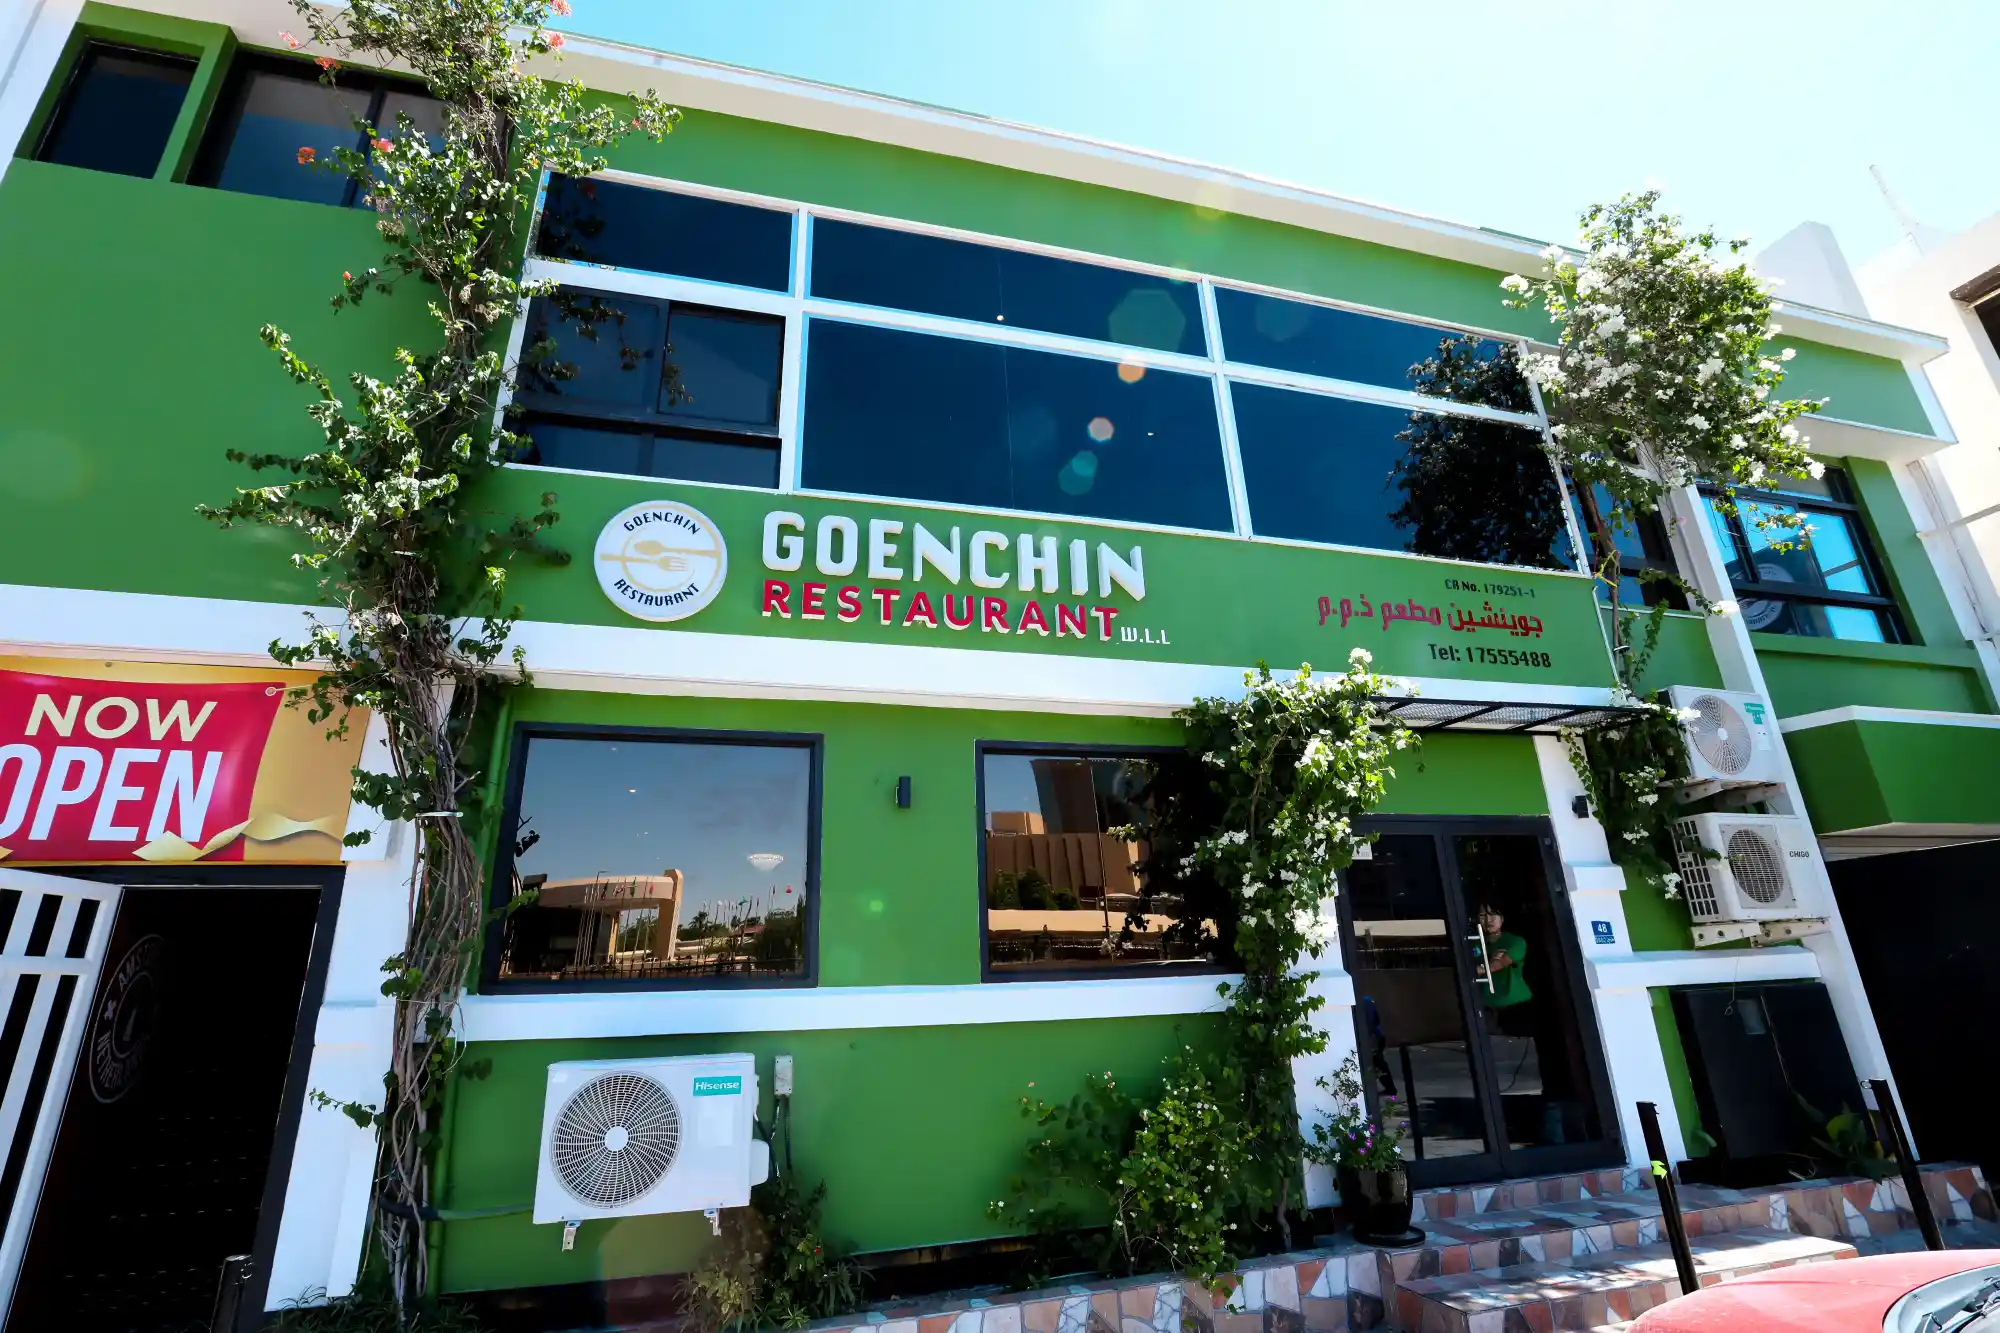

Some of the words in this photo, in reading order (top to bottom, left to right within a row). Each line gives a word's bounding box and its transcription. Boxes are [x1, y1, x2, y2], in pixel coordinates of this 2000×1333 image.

[623, 511, 701, 535] GOENCHIN
[762, 510, 1146, 602] GOENCHIN
[613, 578, 700, 607] RESTAURANT
[1444, 578, 1460, 591] CR
[1461, 580, 1481, 593] No.
[1484, 583, 1536, 599] 179251-1
[762, 578, 1119, 642] RESTAURANT
[1120, 626, 1171, 645] W.L.L
[1381, 598, 1442, 631] مطعم
[1446, 601, 1543, 639] جوينشين
[1428, 643, 1462, 662] Tel:
[1465, 646, 1552, 668] 17555488
[24, 693, 218, 742] NOW
[1597, 923, 1608, 933] 48
[695, 1081, 740, 1091] Hisense
